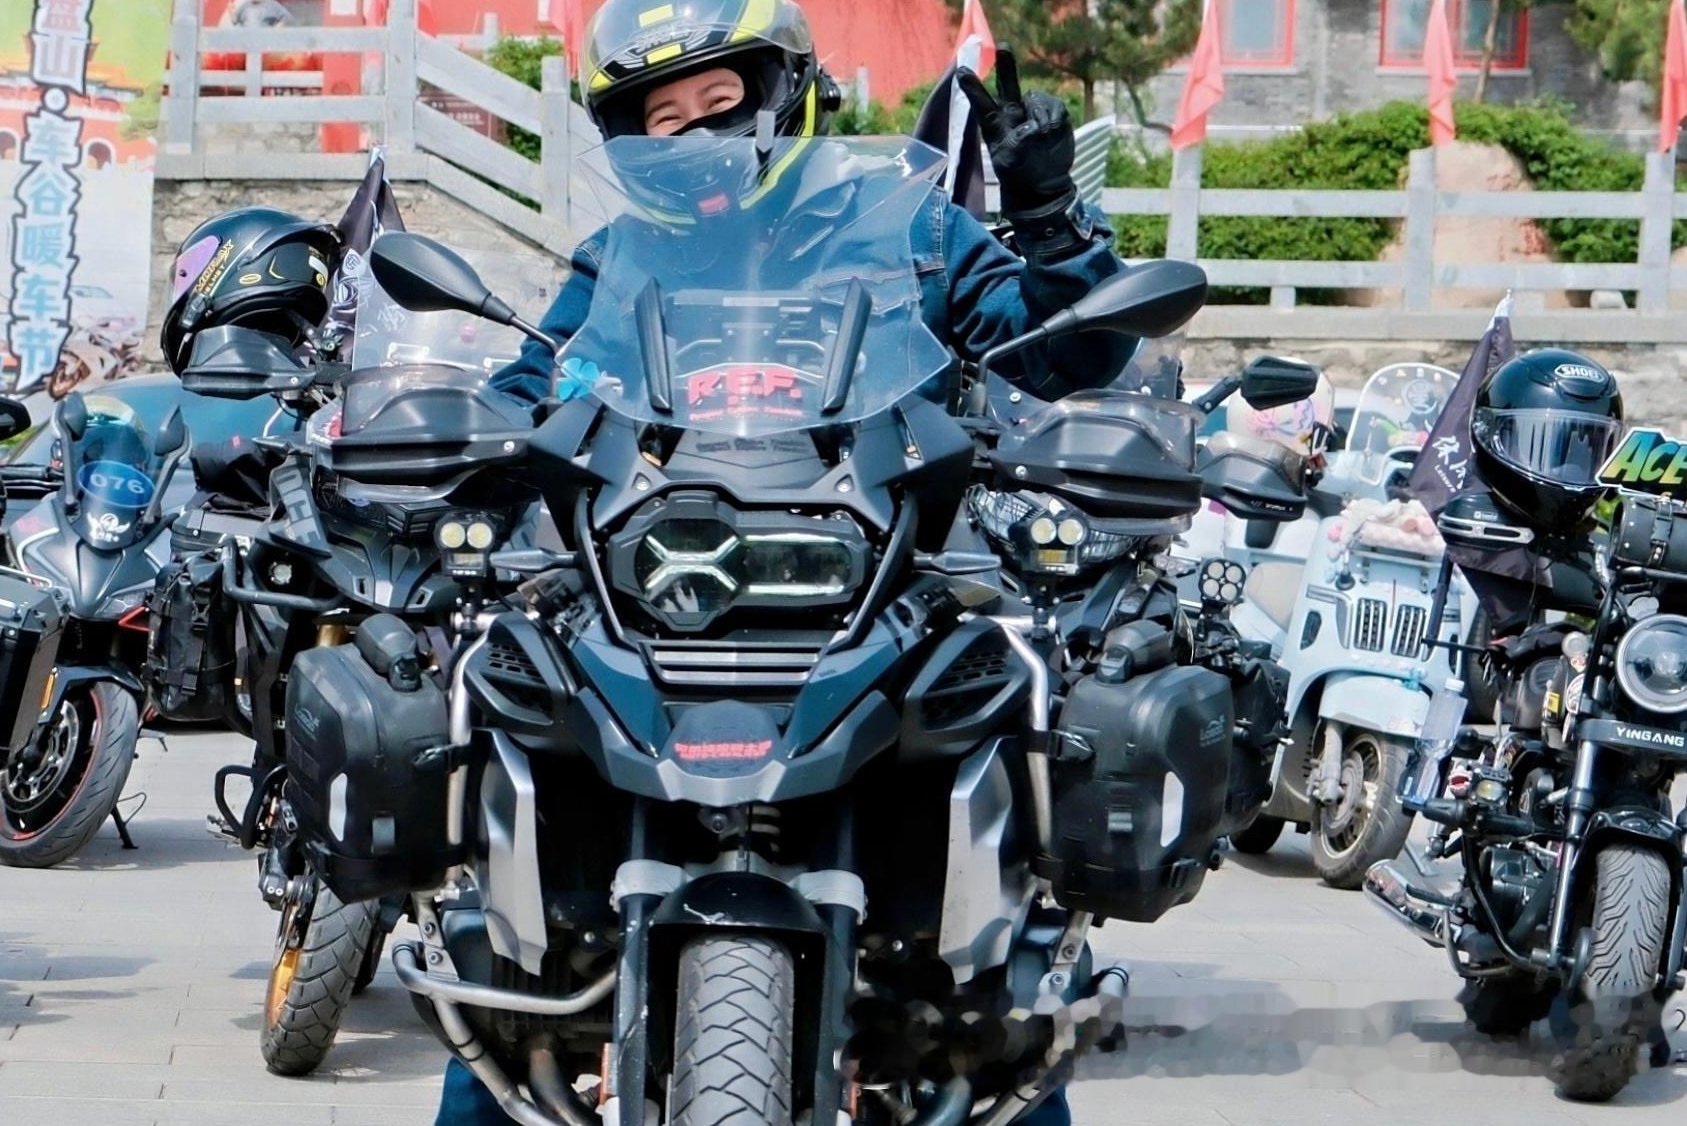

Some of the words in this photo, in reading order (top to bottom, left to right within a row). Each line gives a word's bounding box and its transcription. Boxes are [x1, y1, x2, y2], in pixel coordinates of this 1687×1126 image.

[1561, 365, 1600, 379] SHOEI
[89, 473, 145, 494] 076
[1616, 726, 1685, 747] YINGANG
